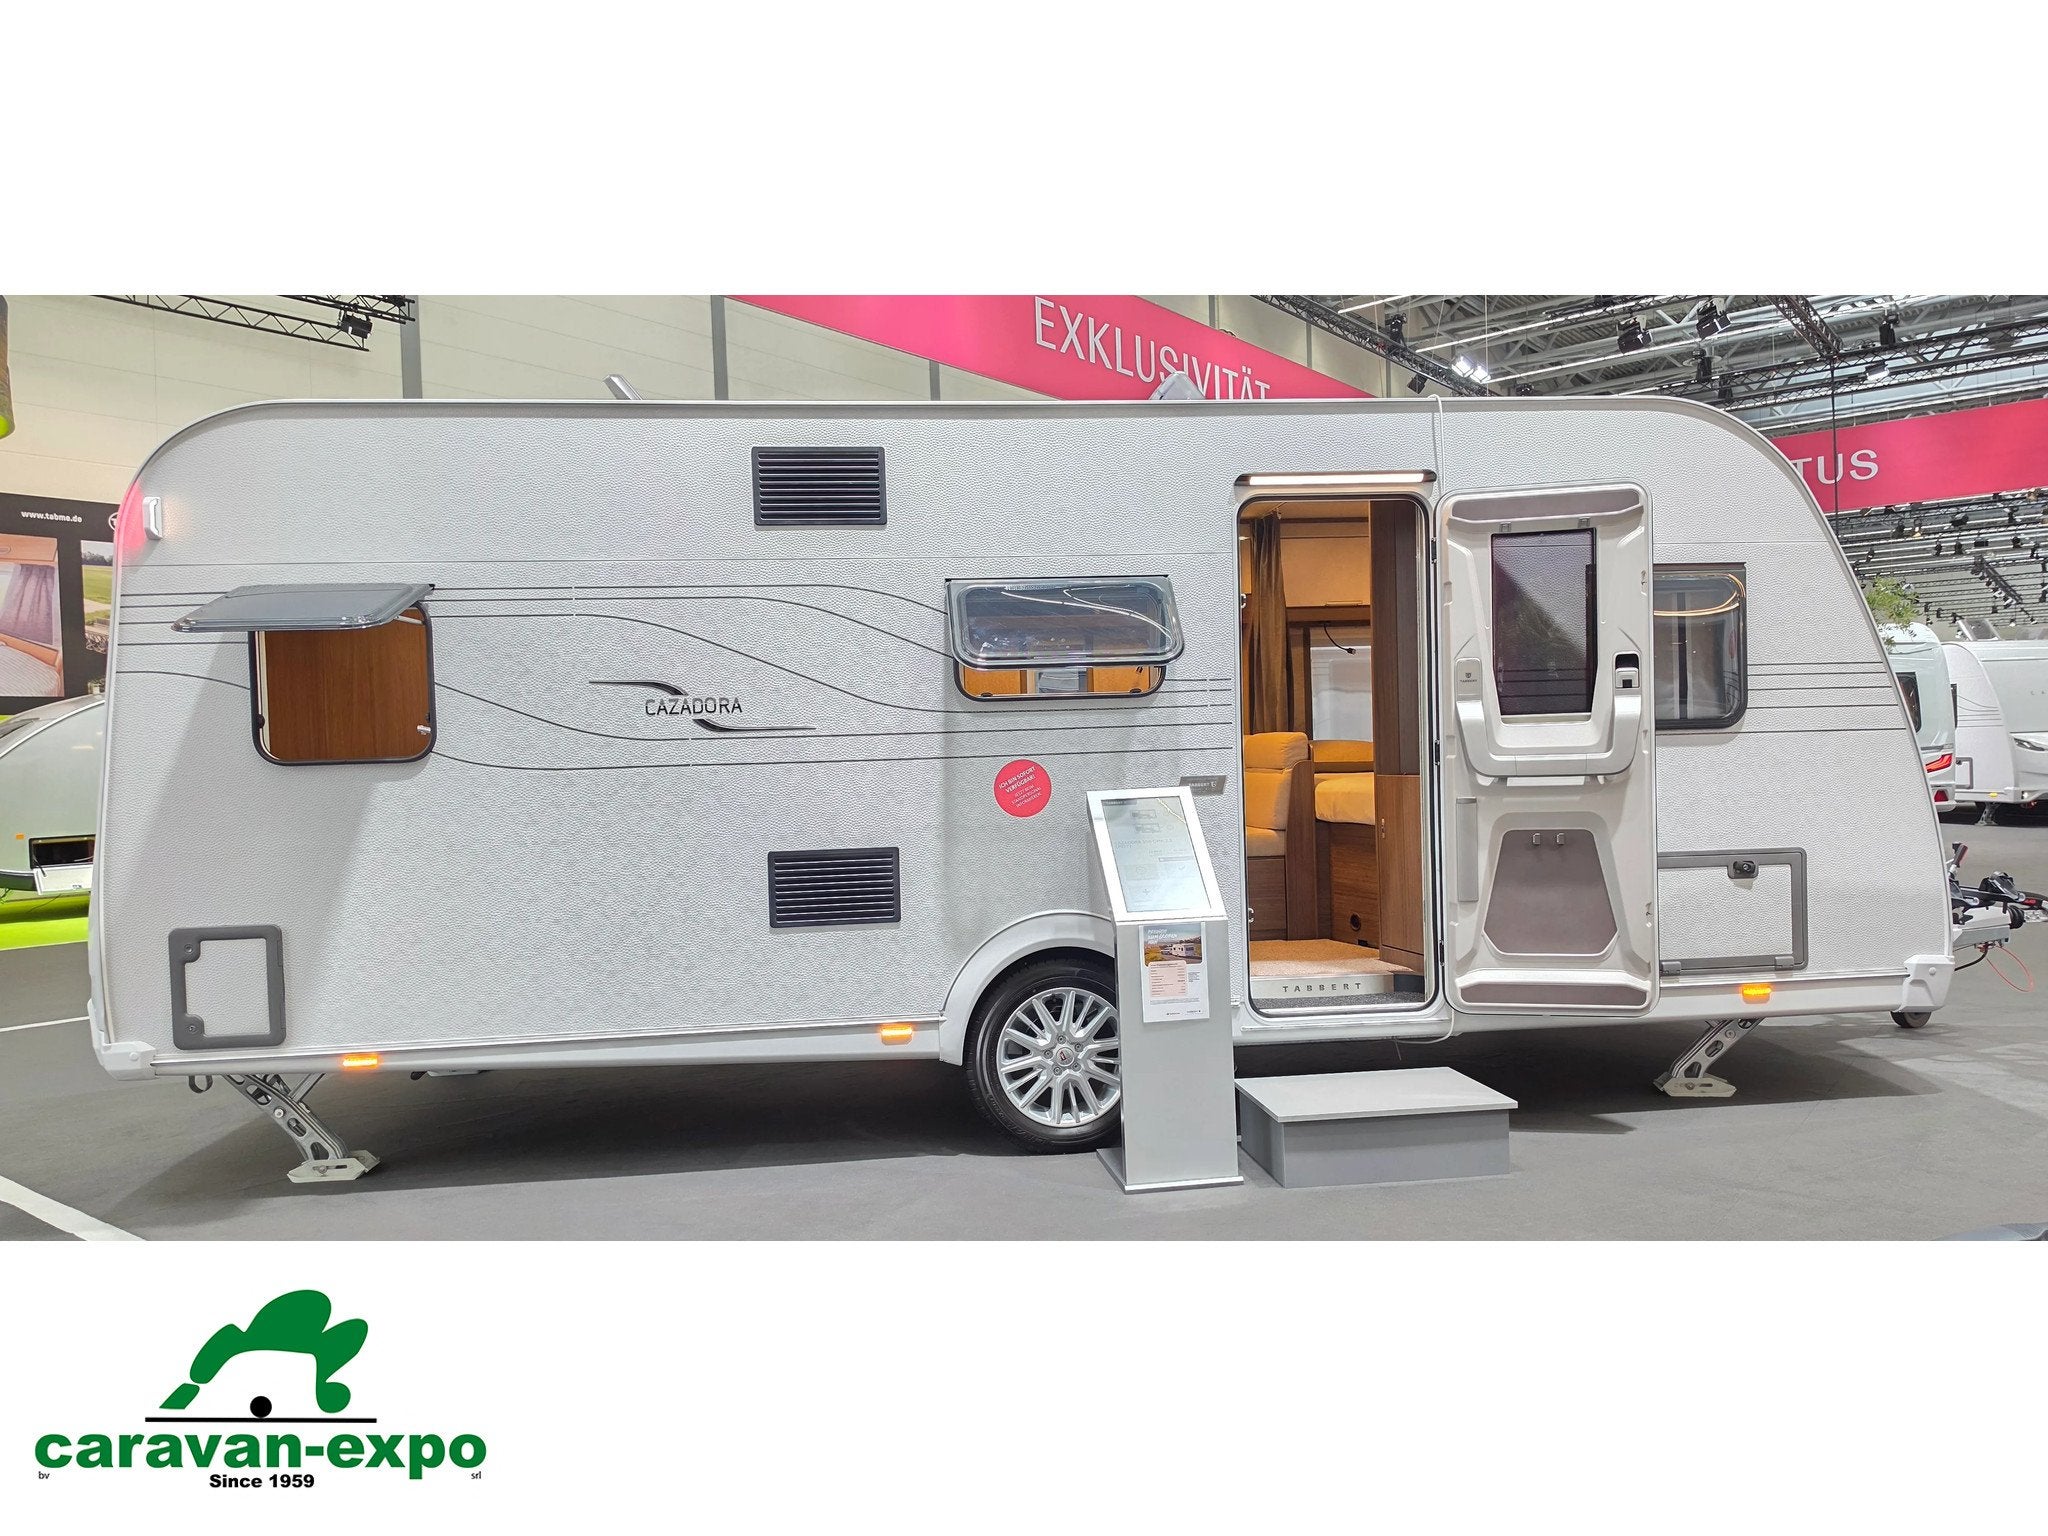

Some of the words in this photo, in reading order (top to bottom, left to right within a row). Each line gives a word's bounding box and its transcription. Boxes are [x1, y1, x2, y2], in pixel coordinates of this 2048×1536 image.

[20, 511, 83, 523] www.tabme.de
[645, 697, 743, 716] CAZADORA
[1017, 766, 1035, 778] SOFORT
[1283, 983, 1361, 993] TABBERT
